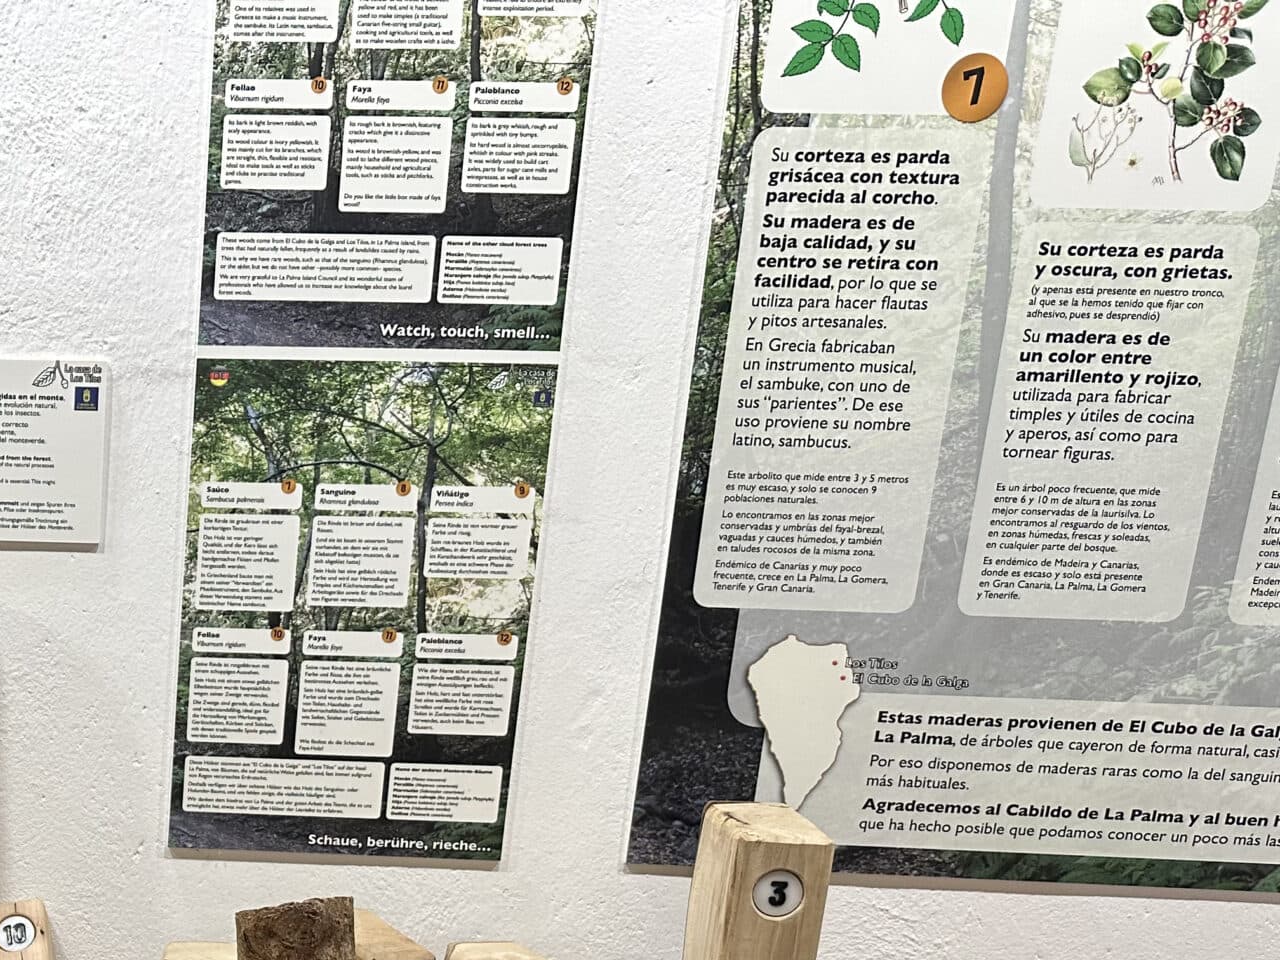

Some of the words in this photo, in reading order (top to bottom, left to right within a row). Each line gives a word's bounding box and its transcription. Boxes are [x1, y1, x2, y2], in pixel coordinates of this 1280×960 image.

[314, 79, 324, 90] 10
[352, 85, 371, 94] Faya
[436, 79, 444, 90] 11
[475, 86, 520, 94] Paloblanco
[560, 80, 569, 91] 12
[963, 66, 984, 105] 7
[771, 147, 789, 161] Su
[794, 149, 865, 163] corteza
[871, 152, 890, 163] es
[895, 149, 949, 166] parda
[767, 167, 844, 186] grisácea
[850, 172, 882, 183] con
[889, 171, 959, 184] textura
[765, 189, 844, 206] parecida
[850, 189, 866, 203] al
[872, 190, 937, 204] corcho.
[1038, 241, 1061, 256] Su
[1067, 244, 1138, 257] corteza
[1144, 247, 1164, 257] es
[1168, 244, 1223, 261] parda
[1034, 264, 1046, 279] y
[1051, 265, 1117, 279] oscura,
[1124, 266, 1156, 277] con
[1161, 264, 1232, 282] grietas.
[380, 323, 436, 338] Watch,
[440, 325, 491, 339] touch,
[493, 326, 549, 338] smell...
[727, 470, 745, 479] Este
[748, 471, 782, 480] arbolito
[784, 474, 801, 482] que
[803, 472, 824, 481] mide
[853, 473, 859, 482] 3
[861, 476, 867, 484] y
[869, 473, 874, 482] 5
[320, 488, 356, 496] Sanguino
[519, 486, 525, 494] 9
[877, 710, 922, 724] Estas
[927, 713, 1002, 727] maderas
[1007, 716, 1096, 731] provienen
[1102, 719, 1123, 732] de
[1129, 720, 1146, 732] El
[1151, 721, 1197, 734] Cubo
[1203, 723, 1224, 735] de
[1229, 724, 1244, 736] la
[861, 798, 980, 814] Agradecemos
[985, 803, 1001, 815] al
[1006, 804, 1072, 818] Cabildo
[1077, 807, 1098, 819] de
[1104, 807, 1124, 820] La
[1130, 809, 1183, 823] Palma
[1188, 814, 1199, 827] y
[1203, 812, 1220, 824] al
[1224, 812, 1268, 826] buen
[308, 834, 362, 848] Schaue,
[367, 836, 427, 850] berühre,
[432, 839, 490, 851] rieche...
[768, 880, 788, 907] 3
[2, 922, 26, 945] 10
